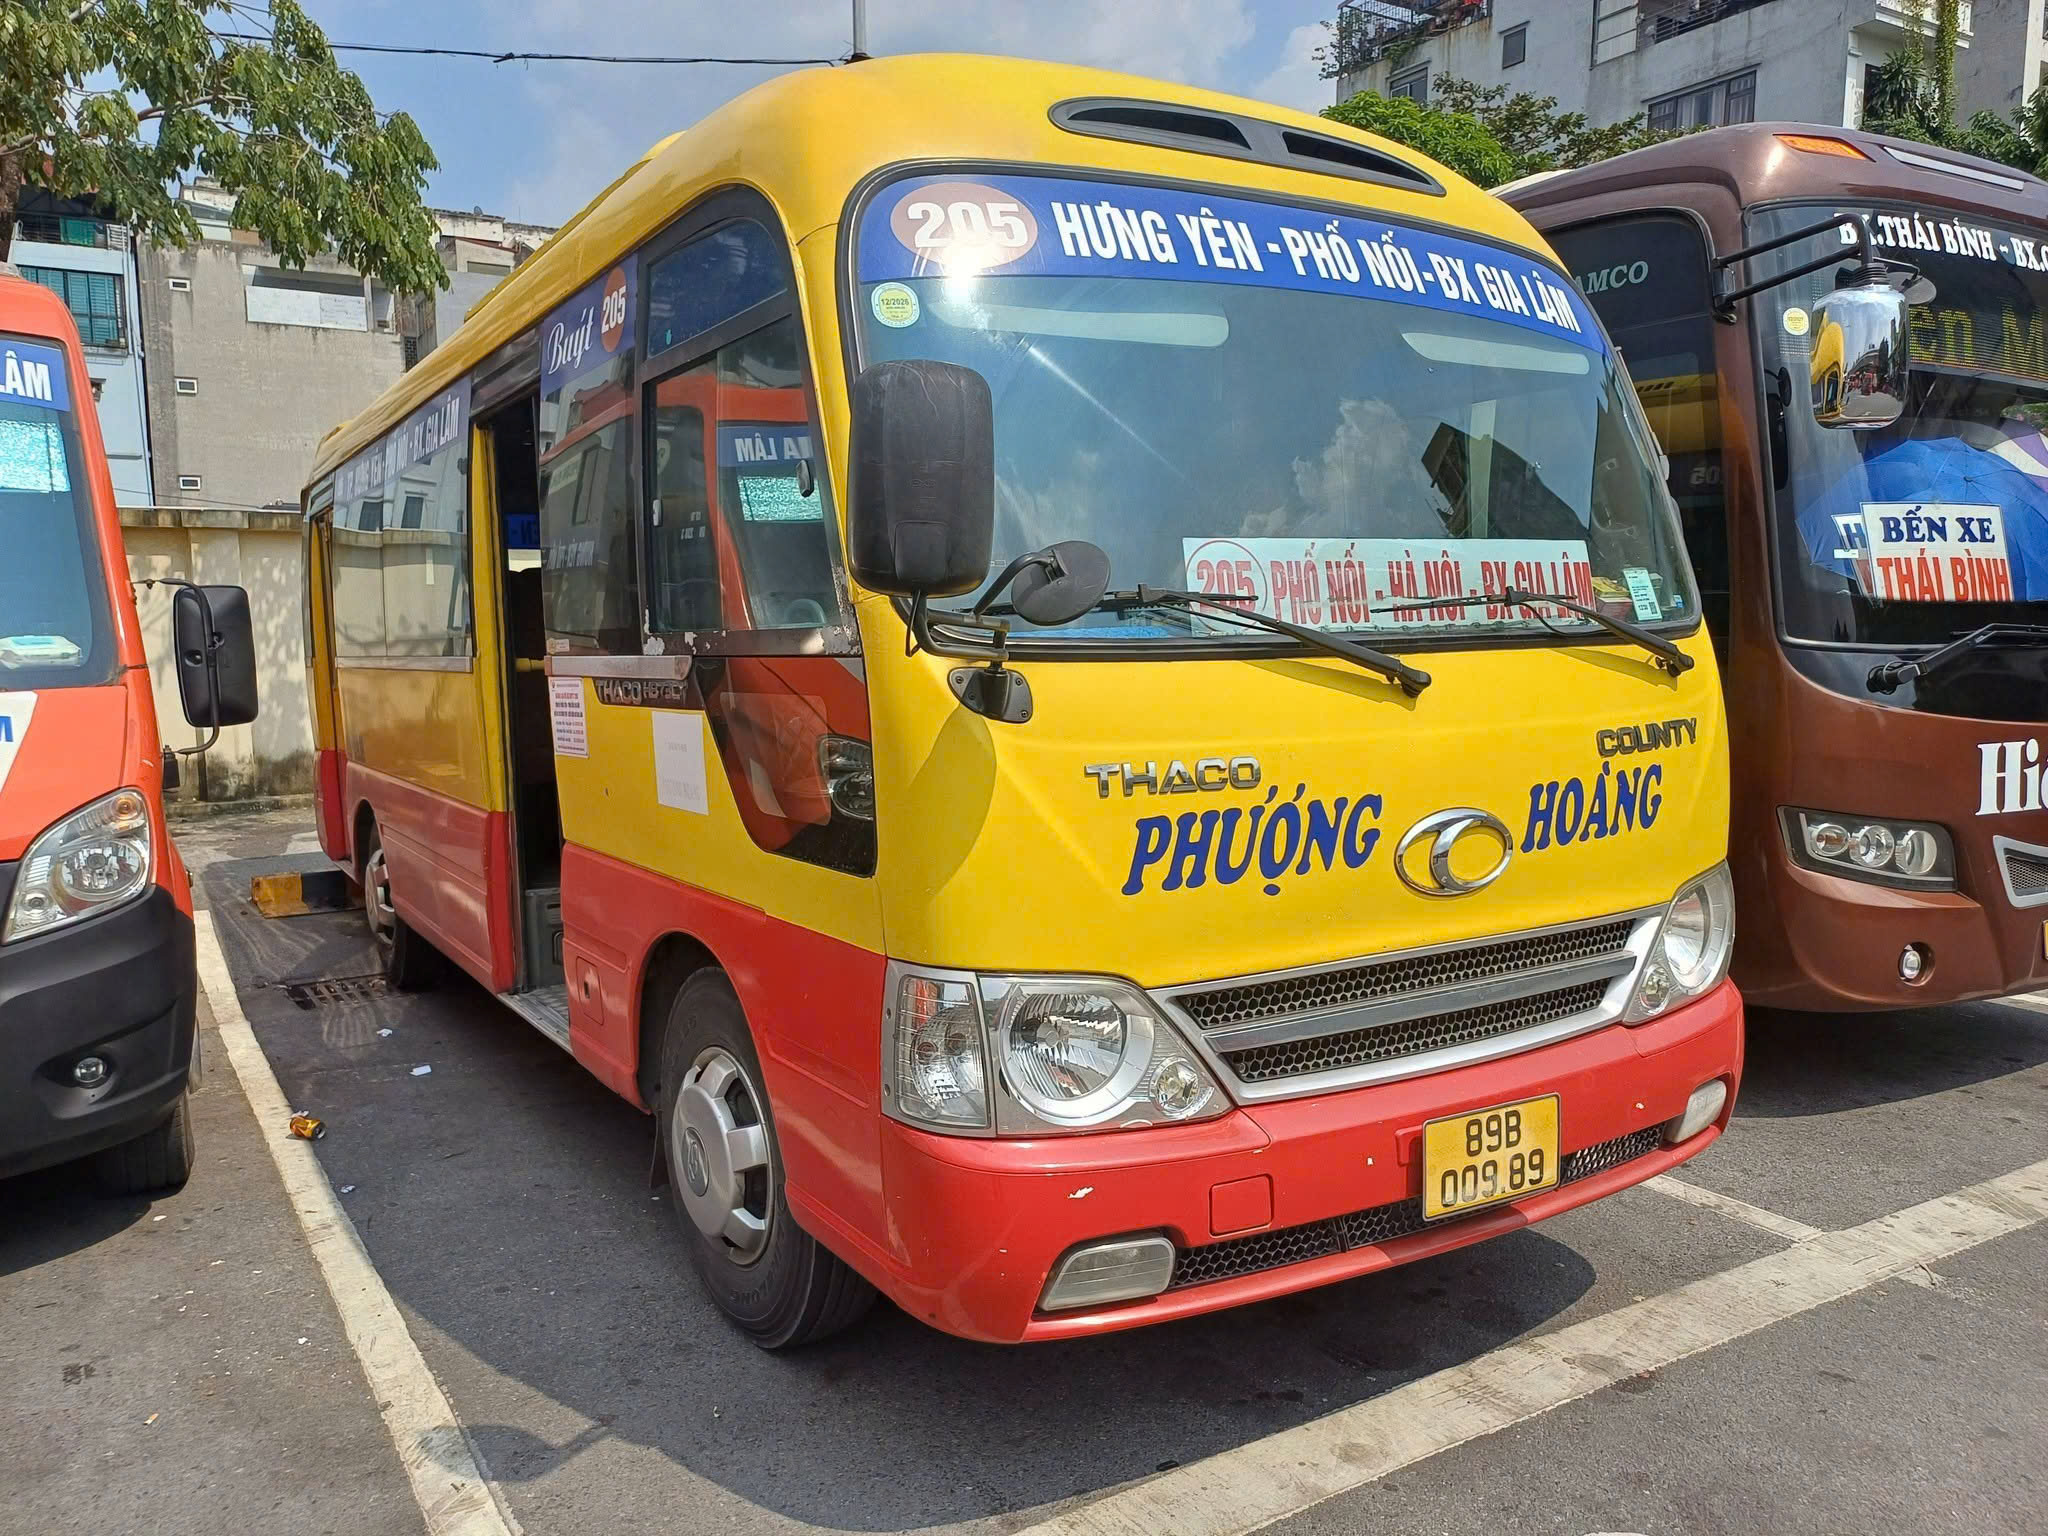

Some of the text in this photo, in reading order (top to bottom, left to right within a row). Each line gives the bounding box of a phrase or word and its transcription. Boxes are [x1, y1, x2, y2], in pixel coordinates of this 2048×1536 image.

[909, 201, 1027, 249] 205
[1051, 200, 1178, 265] HƯNG
[1176, 207, 1264, 272] YÊN
[1279, 220, 1360, 283] PHỐ
[1474, 262, 1530, 317] GIA
[1521, 270, 1582, 333] LÂM
[547, 285, 626, 374] Buýt 205
[0, 349, 53, 402] ÂM
[439, 393, 460, 446] LÂM
[1879, 506, 1996, 544] BẾN XE
[1197, 559, 1257, 614] 205
[1270, 542, 1323, 625] PHỐ
[1325, 542, 1371, 623] NỐI
[1388, 550, 1424, 622] HÀ
[1480, 561, 1514, 620] BX
[1514, 560, 1553, 618] GIA
[1876, 548, 1945, 601] THÁI
[1950, 548, 2011, 601] BÌNH
[595, 680, 642, 705] THACO
[1596, 718, 1697, 758] COUNTY
[1085, 756, 1262, 799] THACO
[1466, 1110, 1521, 1157] 89B
[1441, 1148, 1545, 1208] 009.89
